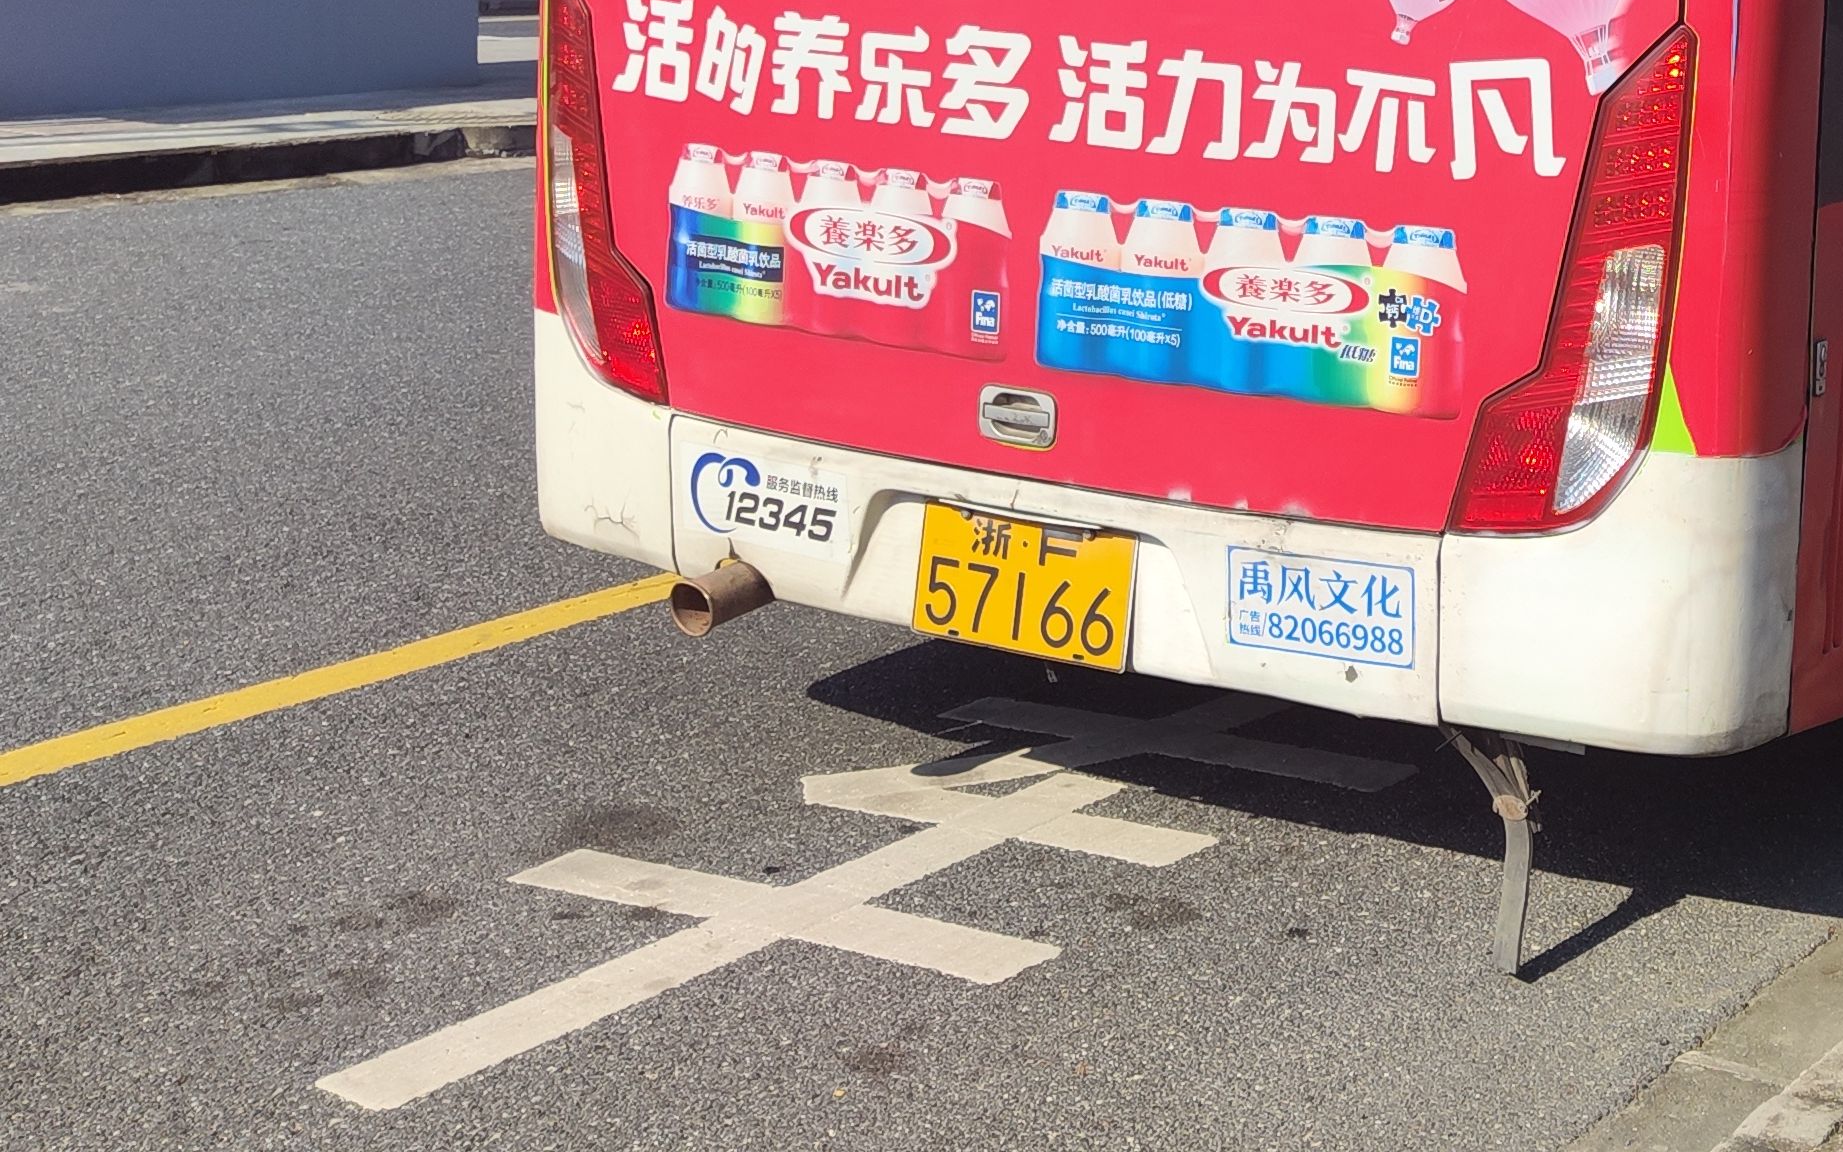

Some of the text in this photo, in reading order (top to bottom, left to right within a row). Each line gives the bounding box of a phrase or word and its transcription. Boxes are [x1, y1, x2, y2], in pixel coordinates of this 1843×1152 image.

[1048, 35, 1567, 180] 活力为不凡
[743, 203, 786, 220] Yakult
[1051, 245, 1104, 263] Yakult
[1134, 254, 1189, 272] Yakult
[812, 261, 925, 302] Yakult
[1227, 315, 1343, 349] Yakult
[766, 474, 839, 504] 服务监督热线
[725, 490, 837, 542] 12345
[971, 518, 1084, 566] 浙·F
[925, 555, 1114, 657] 57166
[1239, 560, 1403, 619] 禹风文化
[1268, 612, 1404, 656] 82066988
